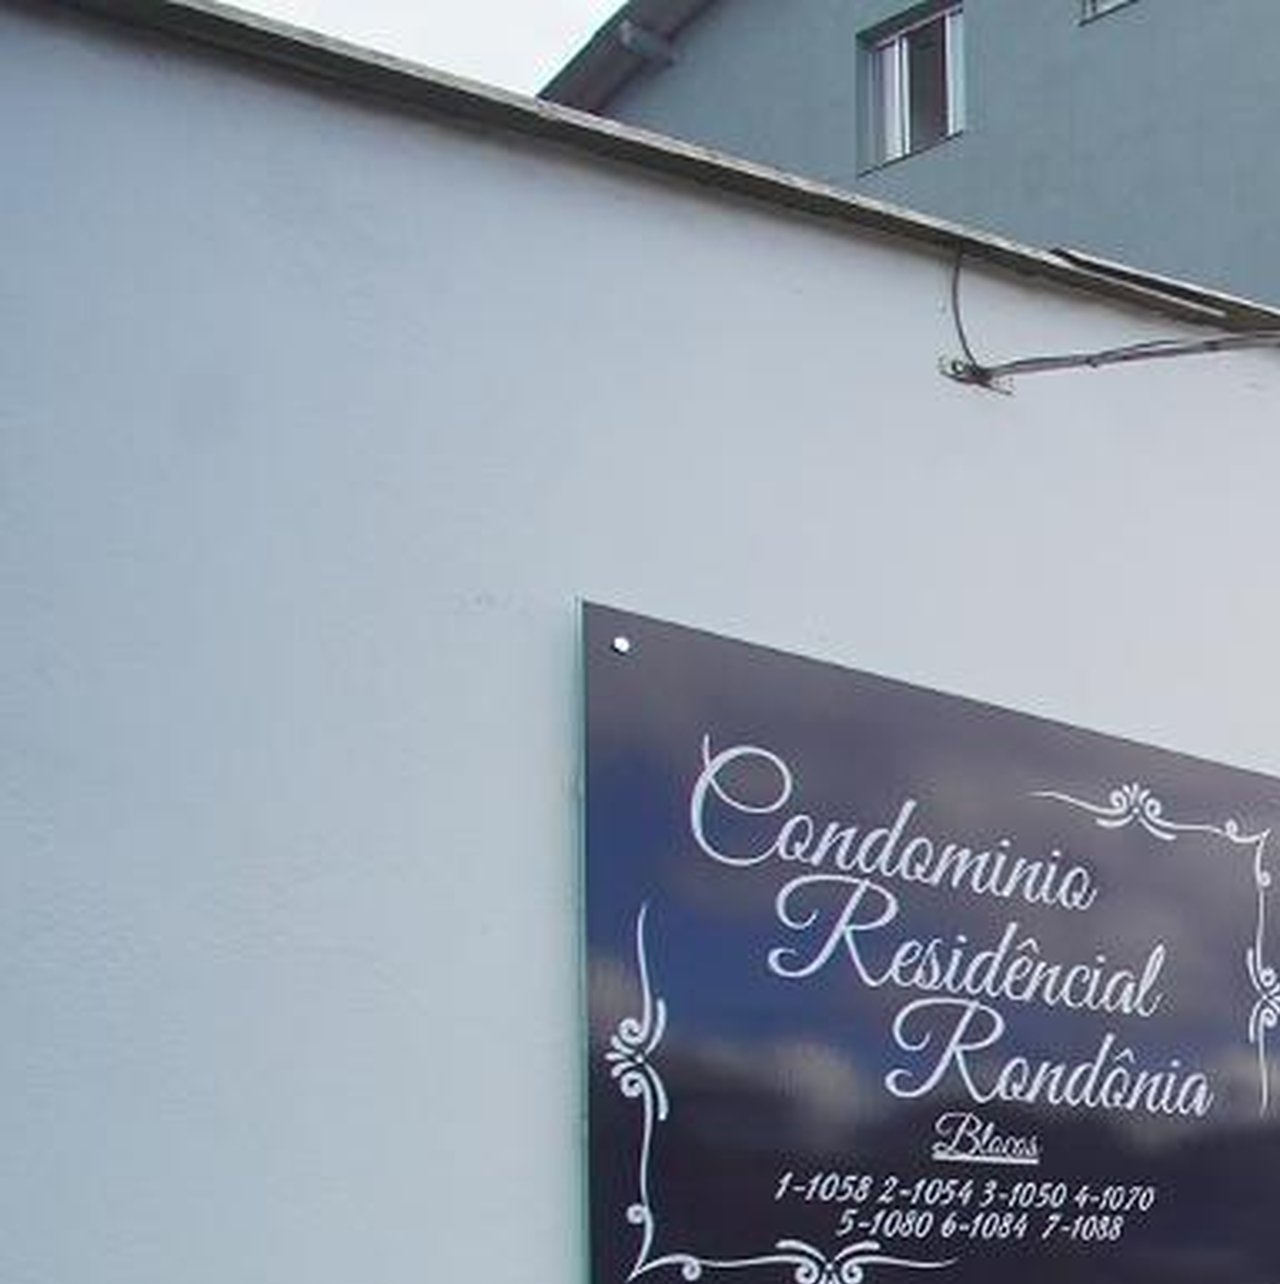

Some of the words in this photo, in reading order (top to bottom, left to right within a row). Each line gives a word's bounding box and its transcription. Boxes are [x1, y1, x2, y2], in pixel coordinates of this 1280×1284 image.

[691, 734, 1098, 910] Condominio
[768, 874, 1166, 1017] Residêncial
[885, 997, 1215, 1117] Rondônia
[775, 1171, 874, 1203] 1-1058
[876, 1175, 974, 1207] 2-1054
[979, 1179, 1068, 1209] 3-1050
[1074, 1184, 1156, 1212] 4-1070
[835, 1208, 934, 1238] 5-1080
[941, 1211, 1029, 1240] 6-1084
